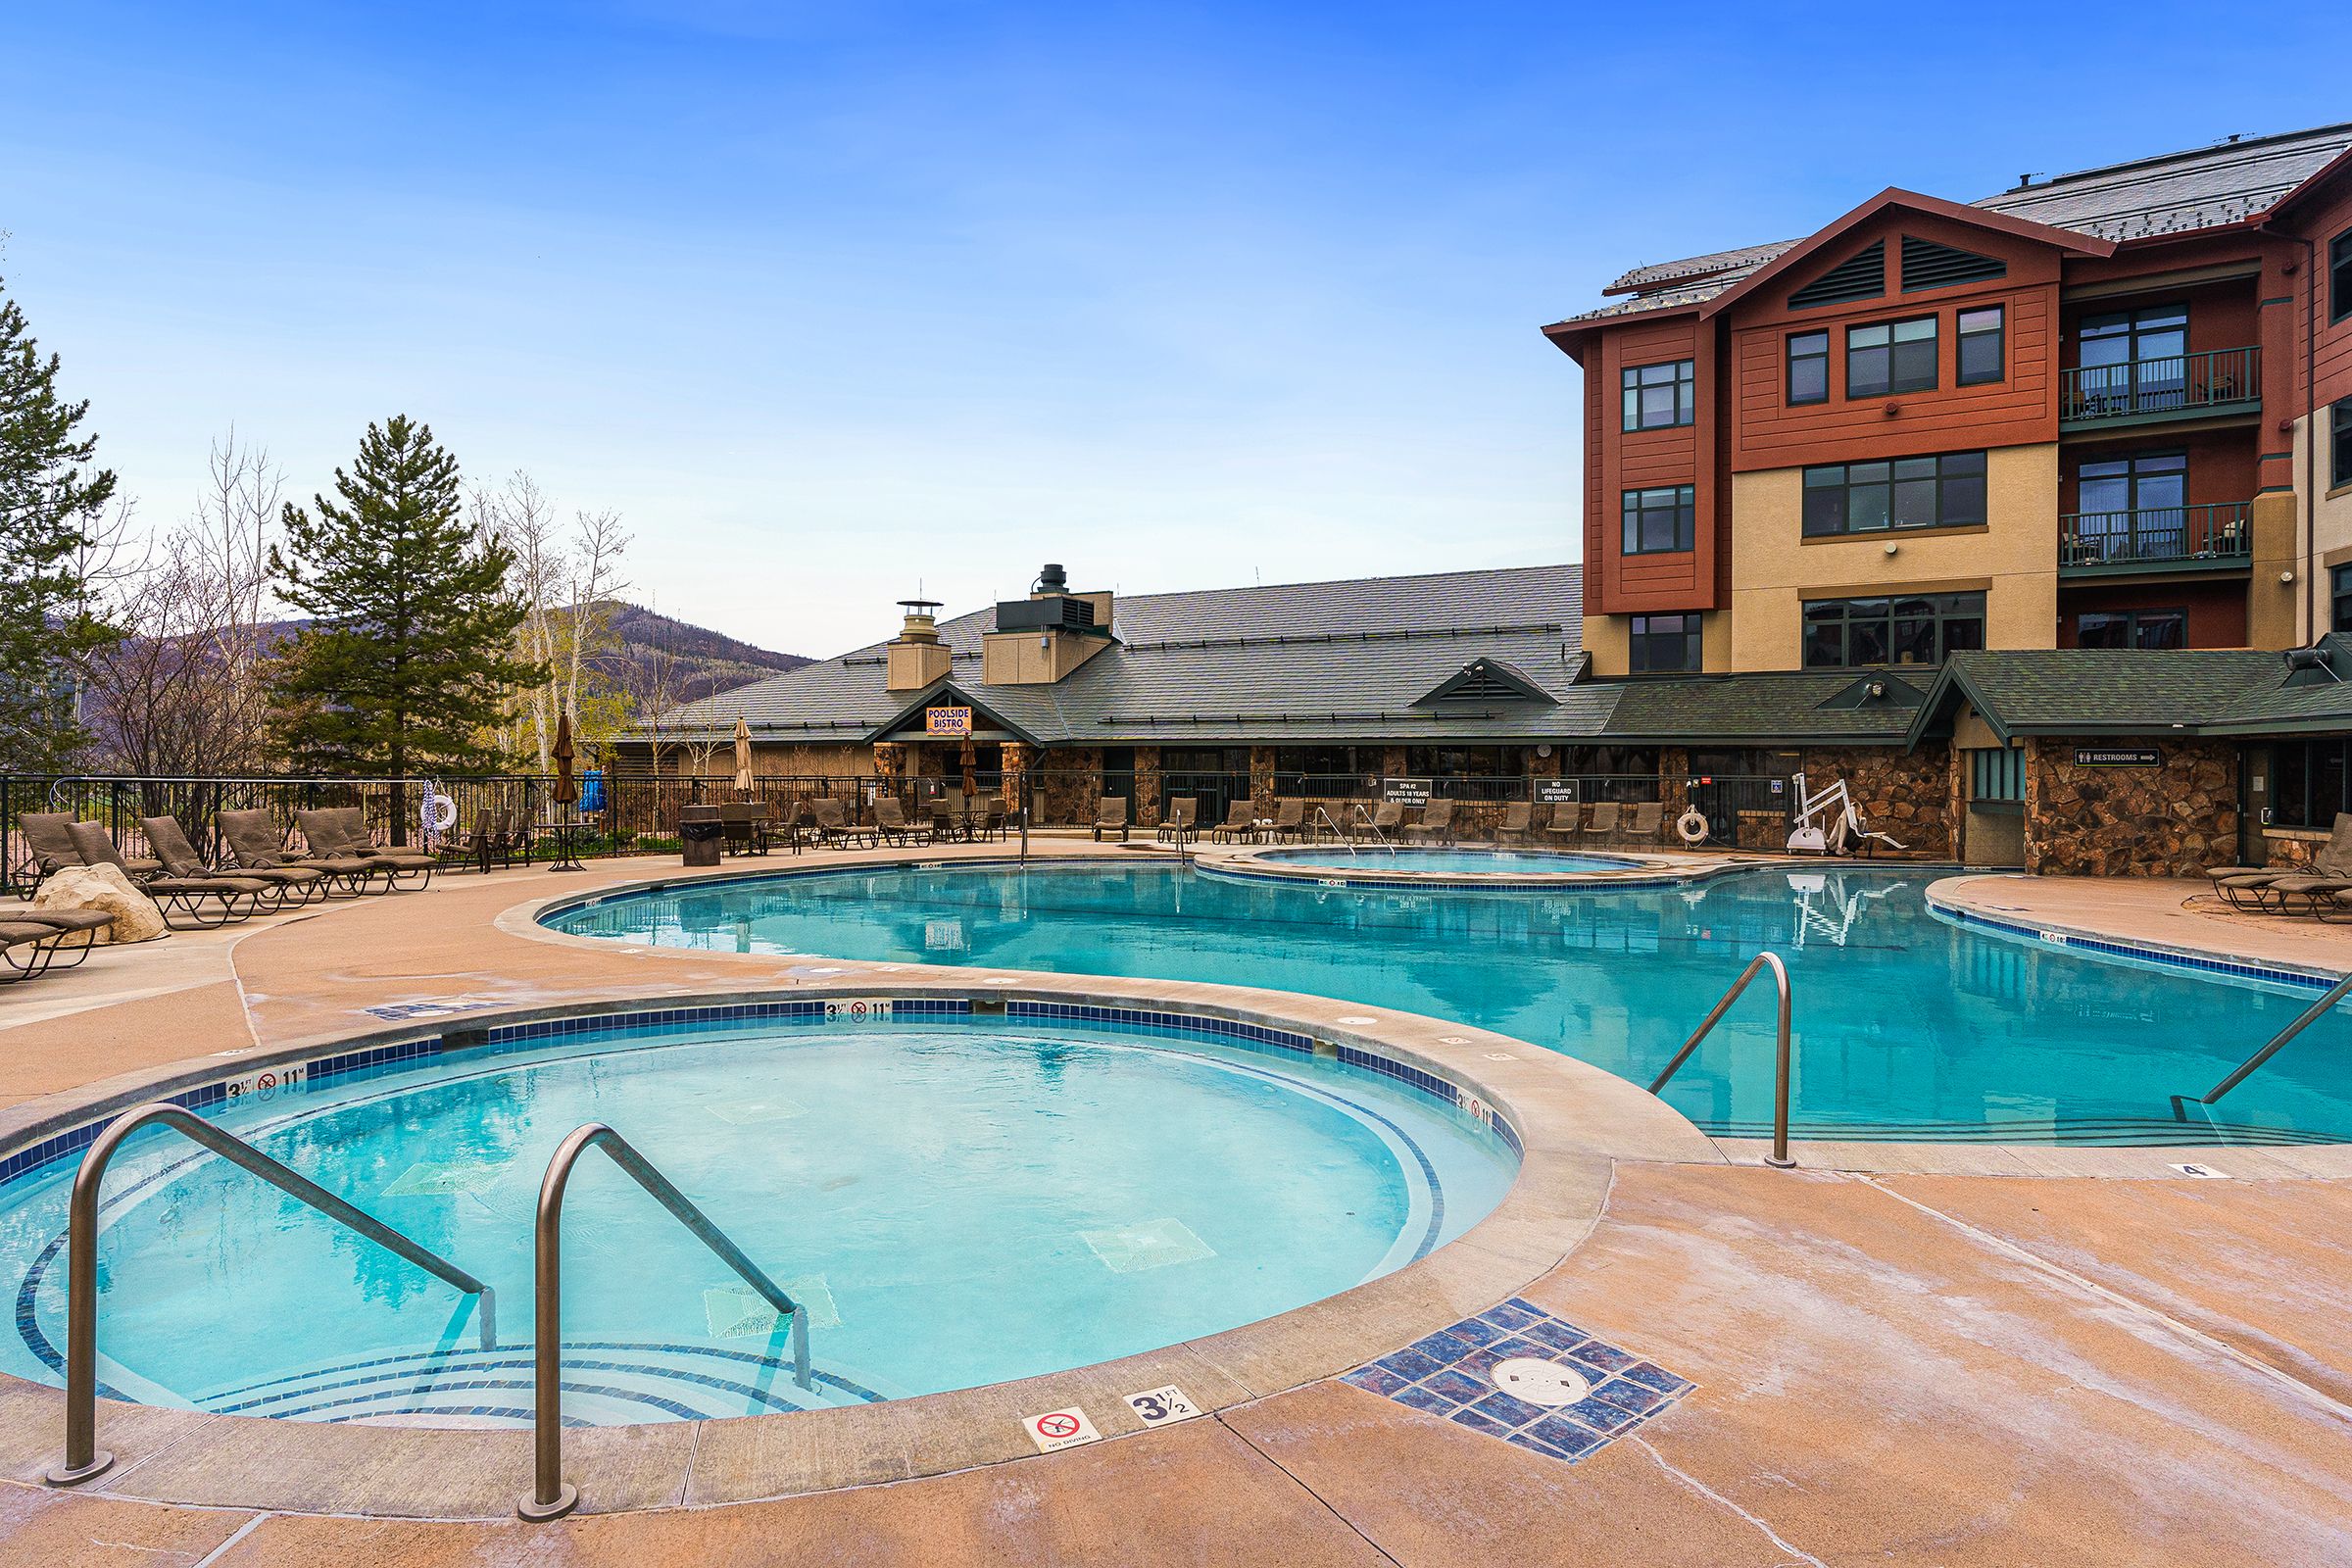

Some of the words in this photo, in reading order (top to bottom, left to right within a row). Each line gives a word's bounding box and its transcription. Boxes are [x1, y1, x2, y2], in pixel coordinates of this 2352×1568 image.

[928, 709, 969, 718] POOLSIDE
[934, 718, 963, 728] BISTRO
[2182, 1165, 2209, 1176] 4
[1063, 1434, 1092, 1446] DIVING
